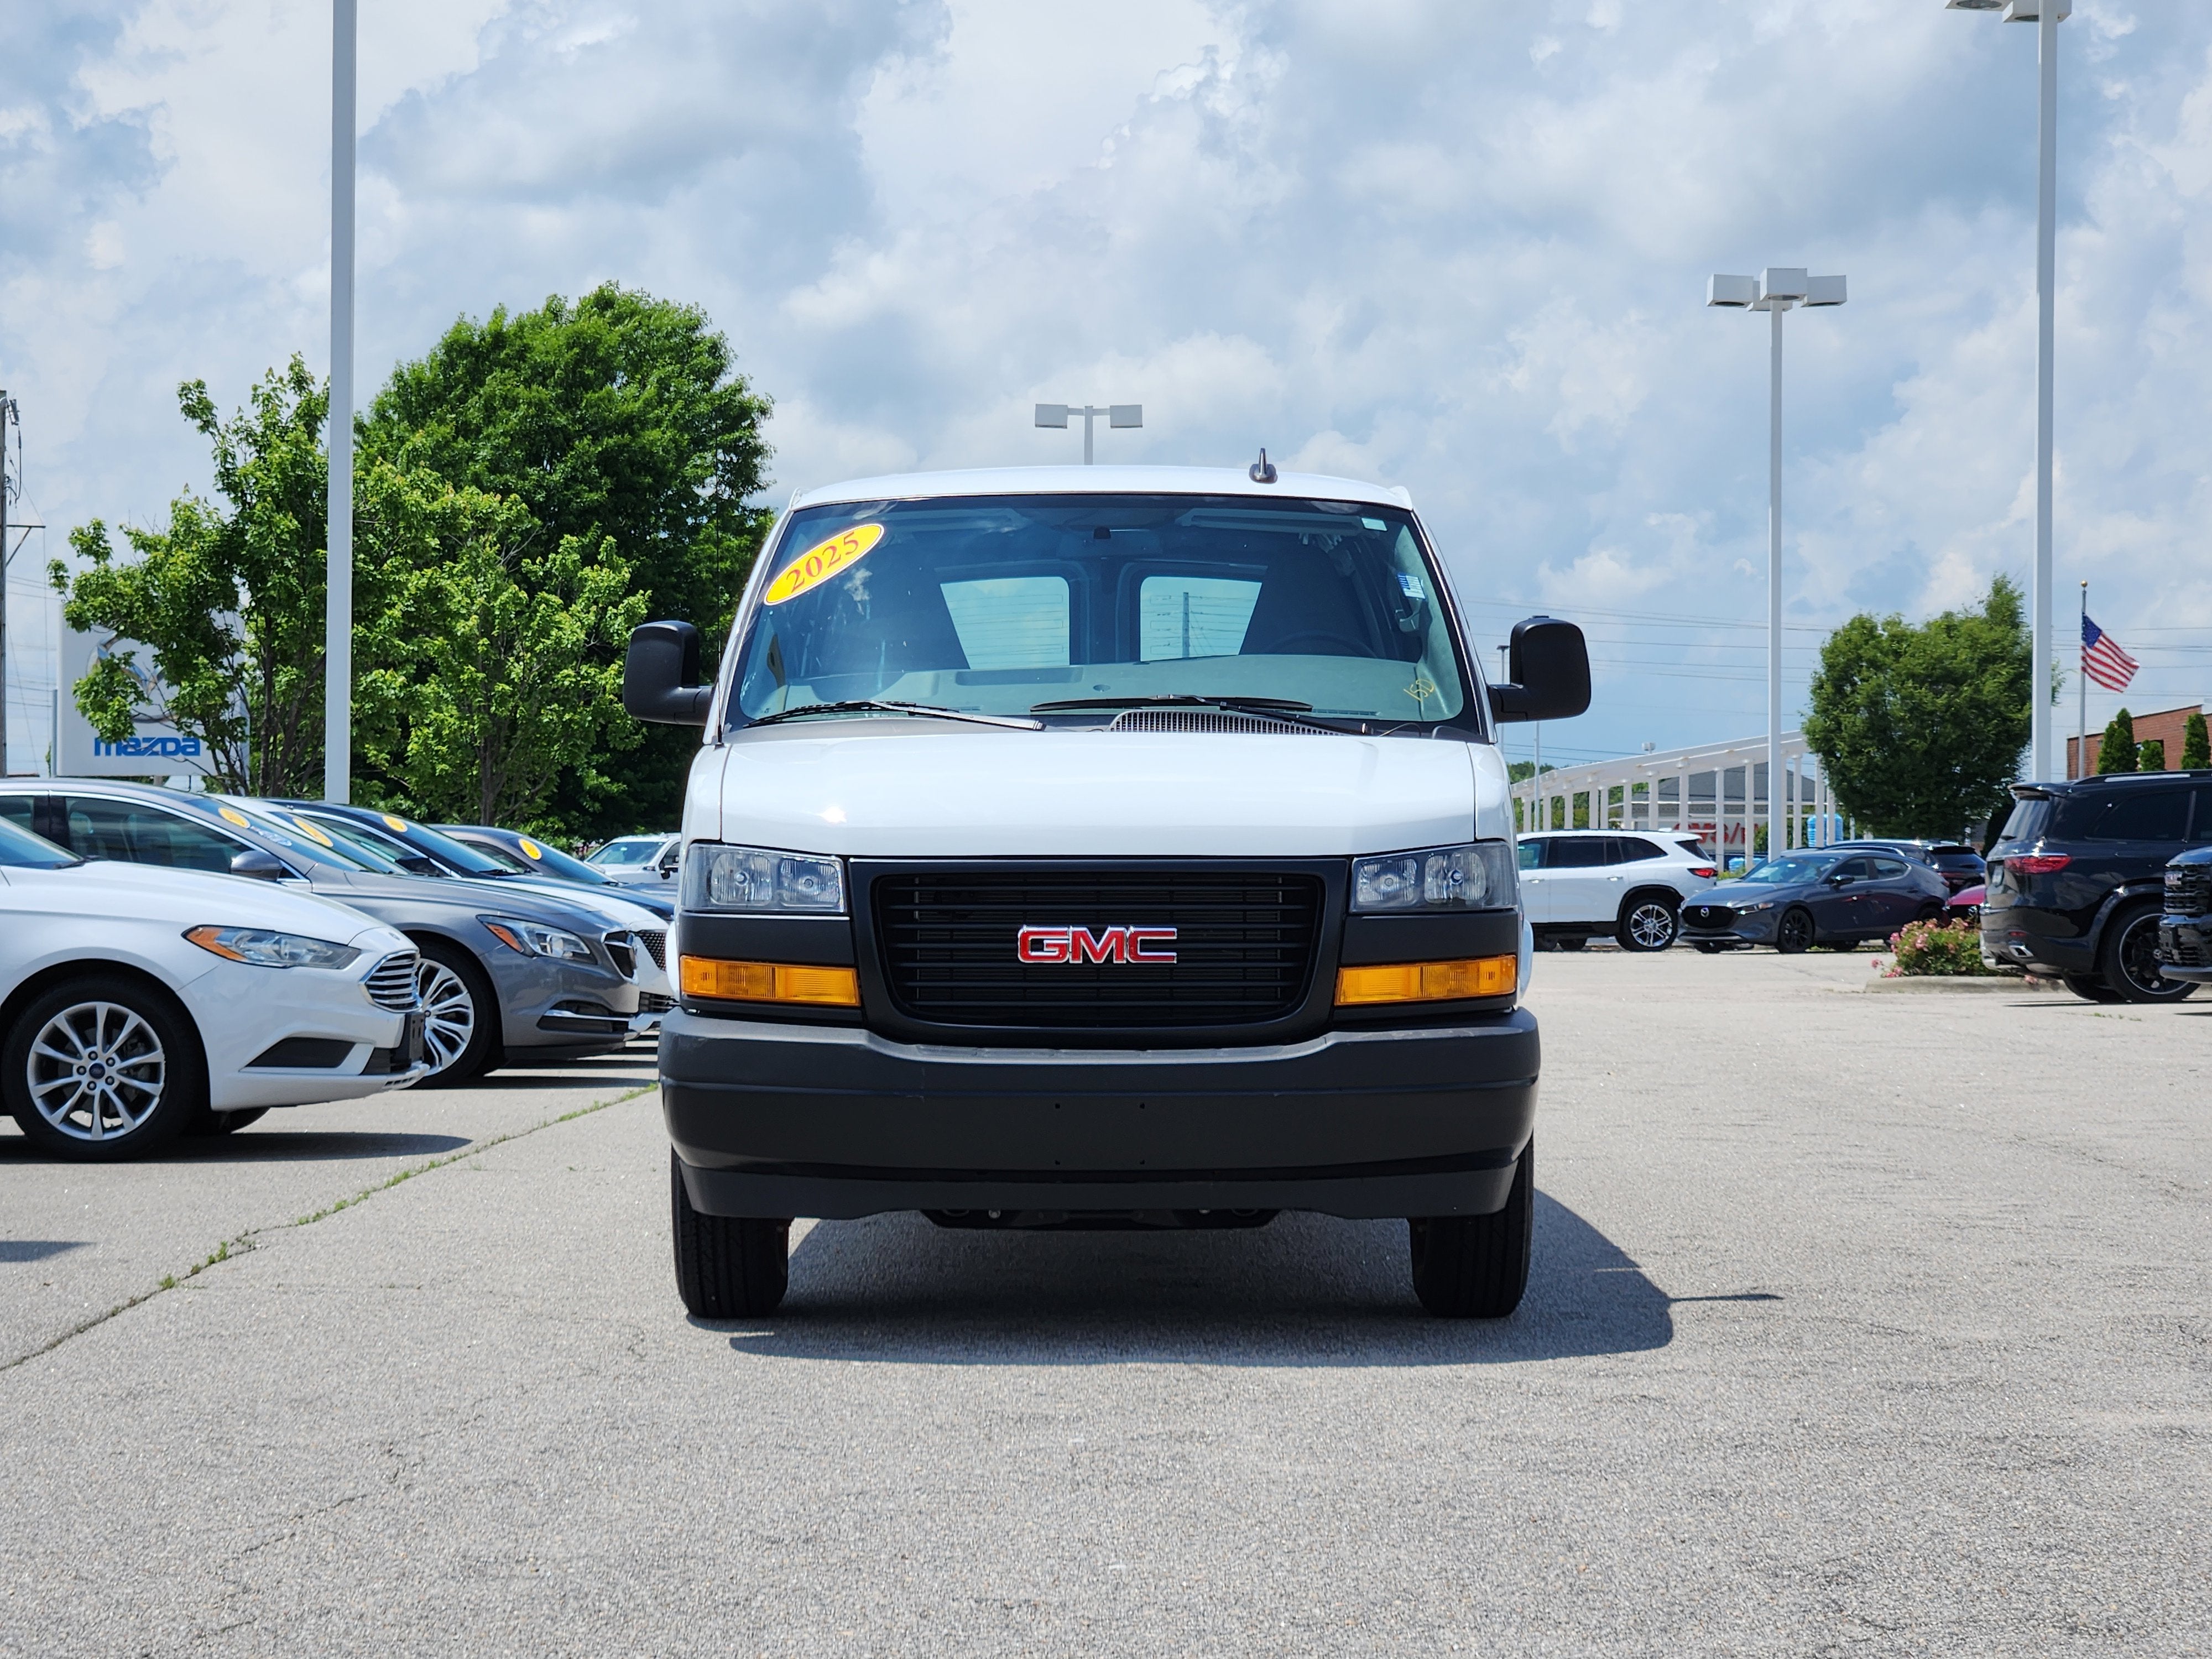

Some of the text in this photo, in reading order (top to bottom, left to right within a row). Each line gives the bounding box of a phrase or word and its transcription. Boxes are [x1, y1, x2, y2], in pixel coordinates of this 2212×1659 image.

[786, 531, 859, 593] 2025
[94, 737, 201, 757] mazda
[1018, 926, 1177, 963] GMC
